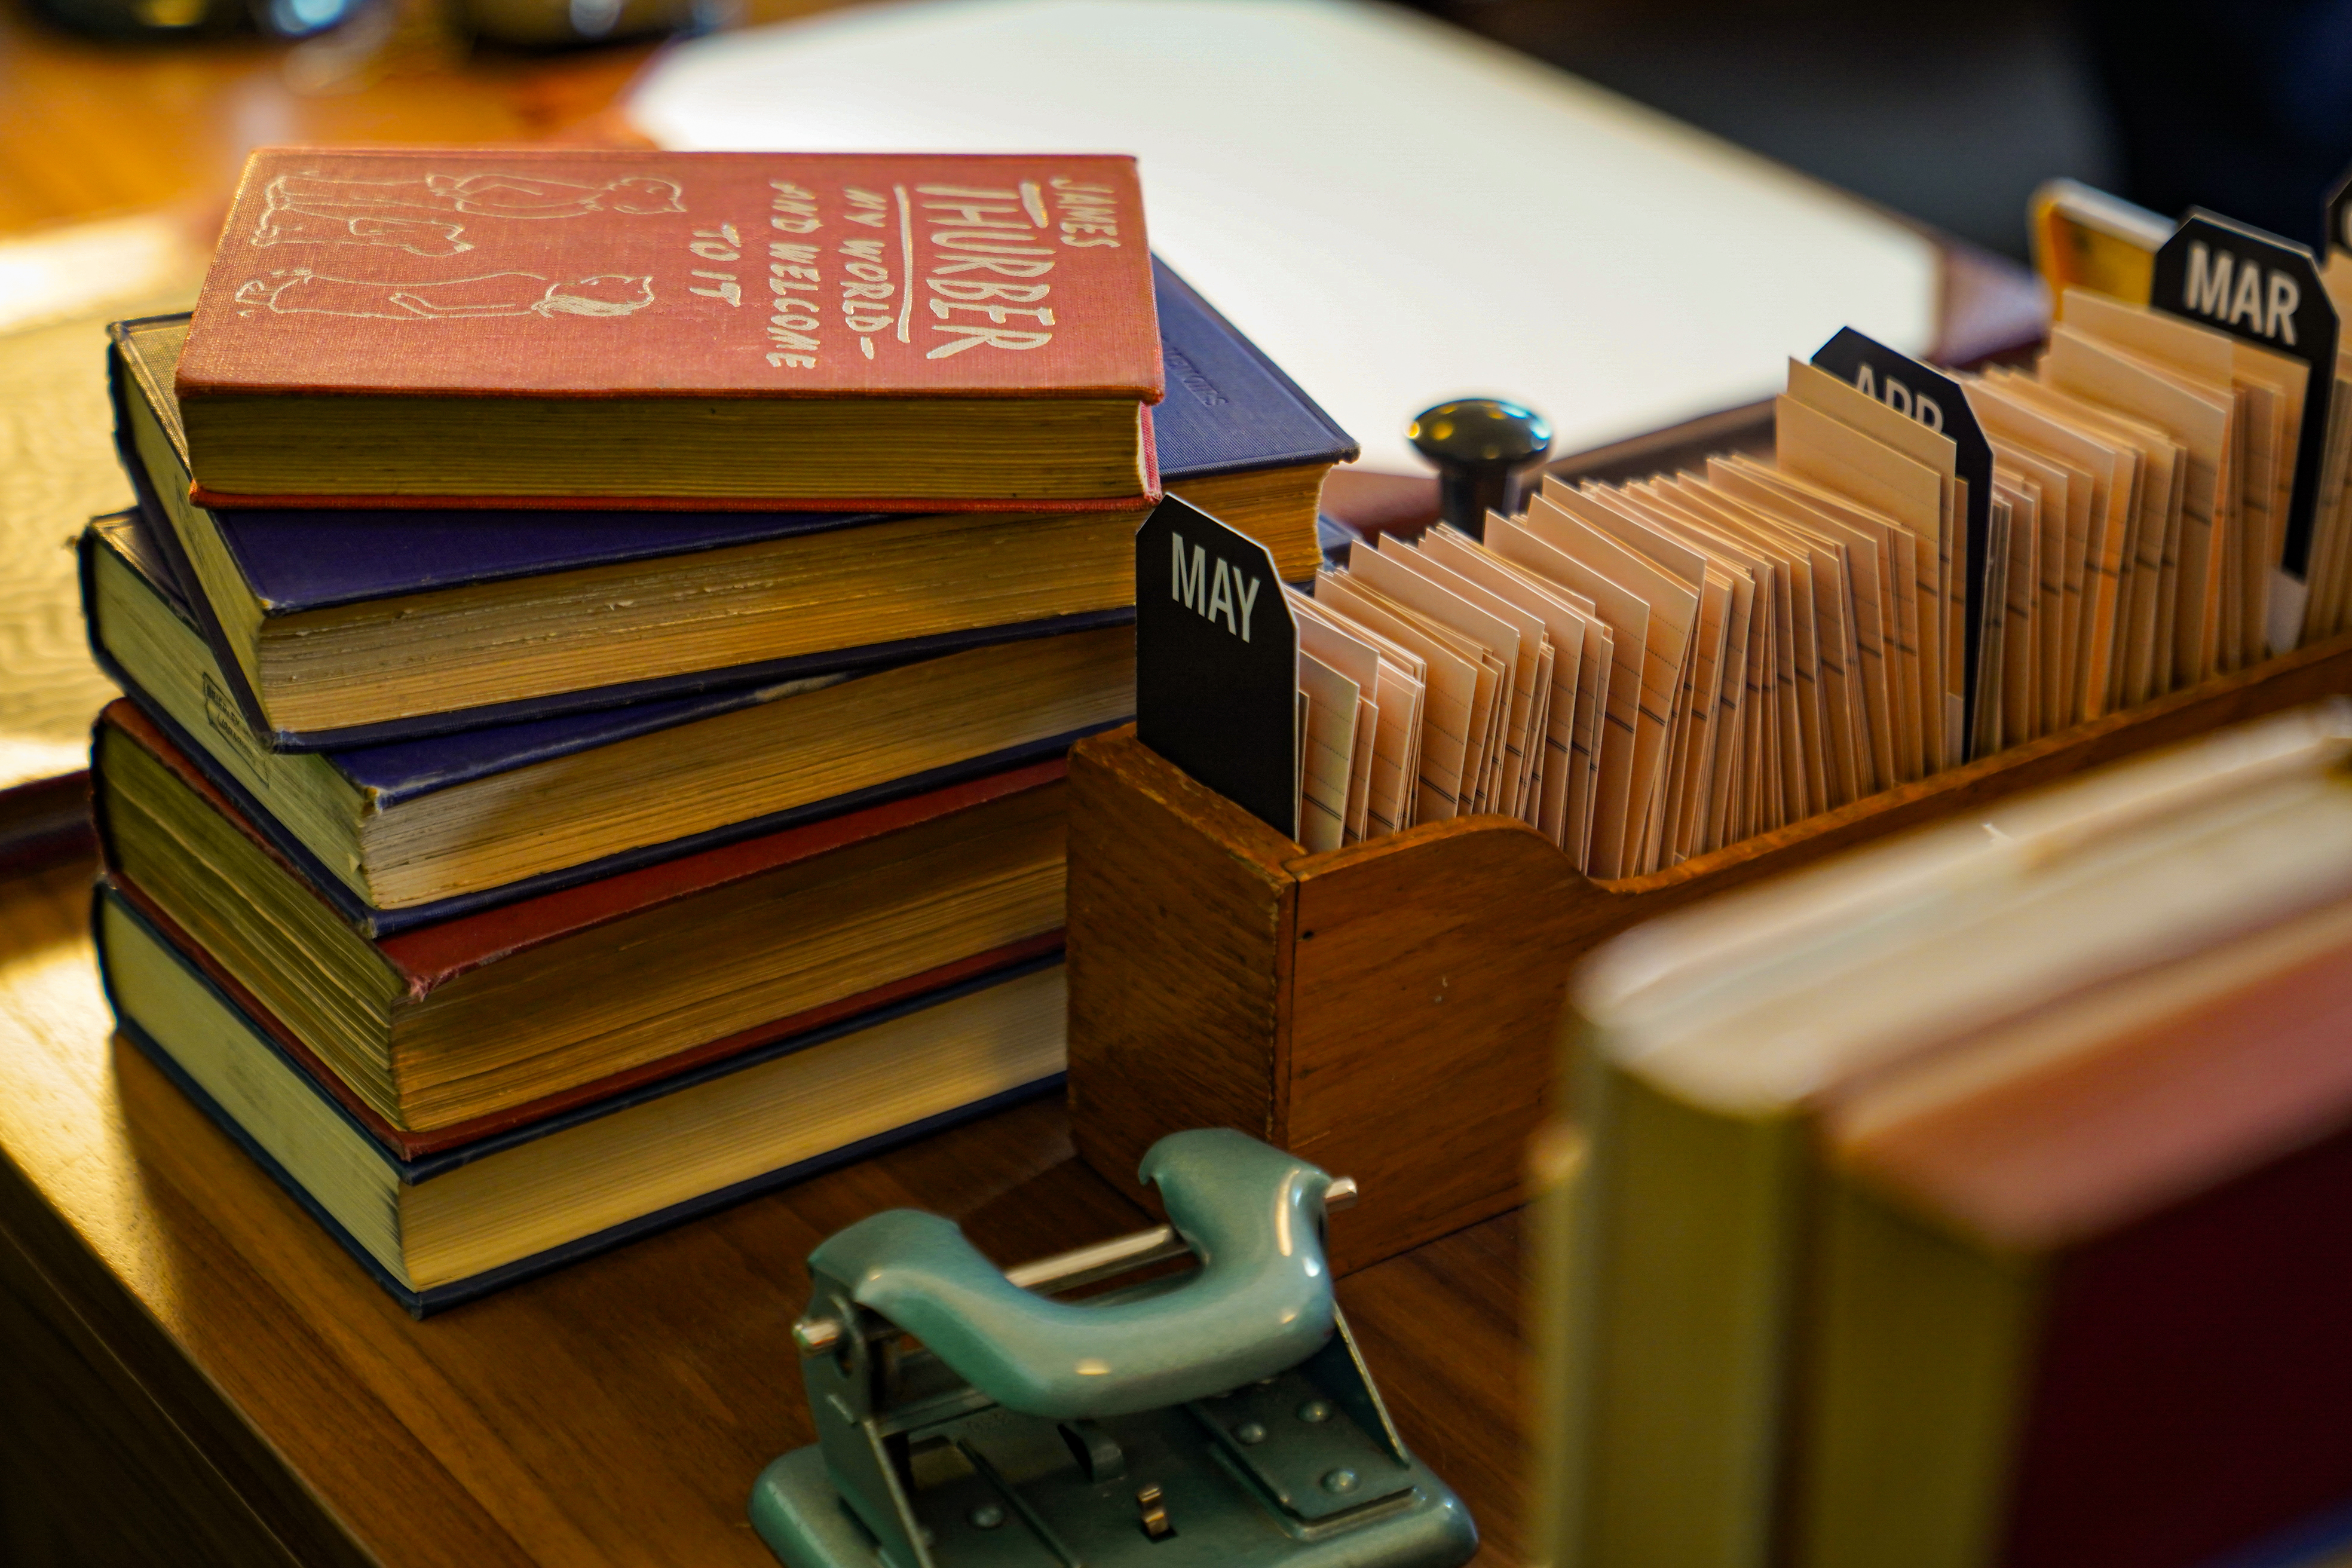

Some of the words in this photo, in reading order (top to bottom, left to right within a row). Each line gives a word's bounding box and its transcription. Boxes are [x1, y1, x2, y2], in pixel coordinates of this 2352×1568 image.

[769, 179, 823, 234] AND
[844, 186, 886, 228] MY
[1051, 177, 1121, 248] JAMES
[689, 223, 741, 262] TO
[915, 180, 1056, 359] THURBER
[690, 270, 741, 307] IT
[765, 244, 820, 369] WELCOME
[2185, 242, 2300, 346] MAR
[1172, 532, 1260, 643] MAY
